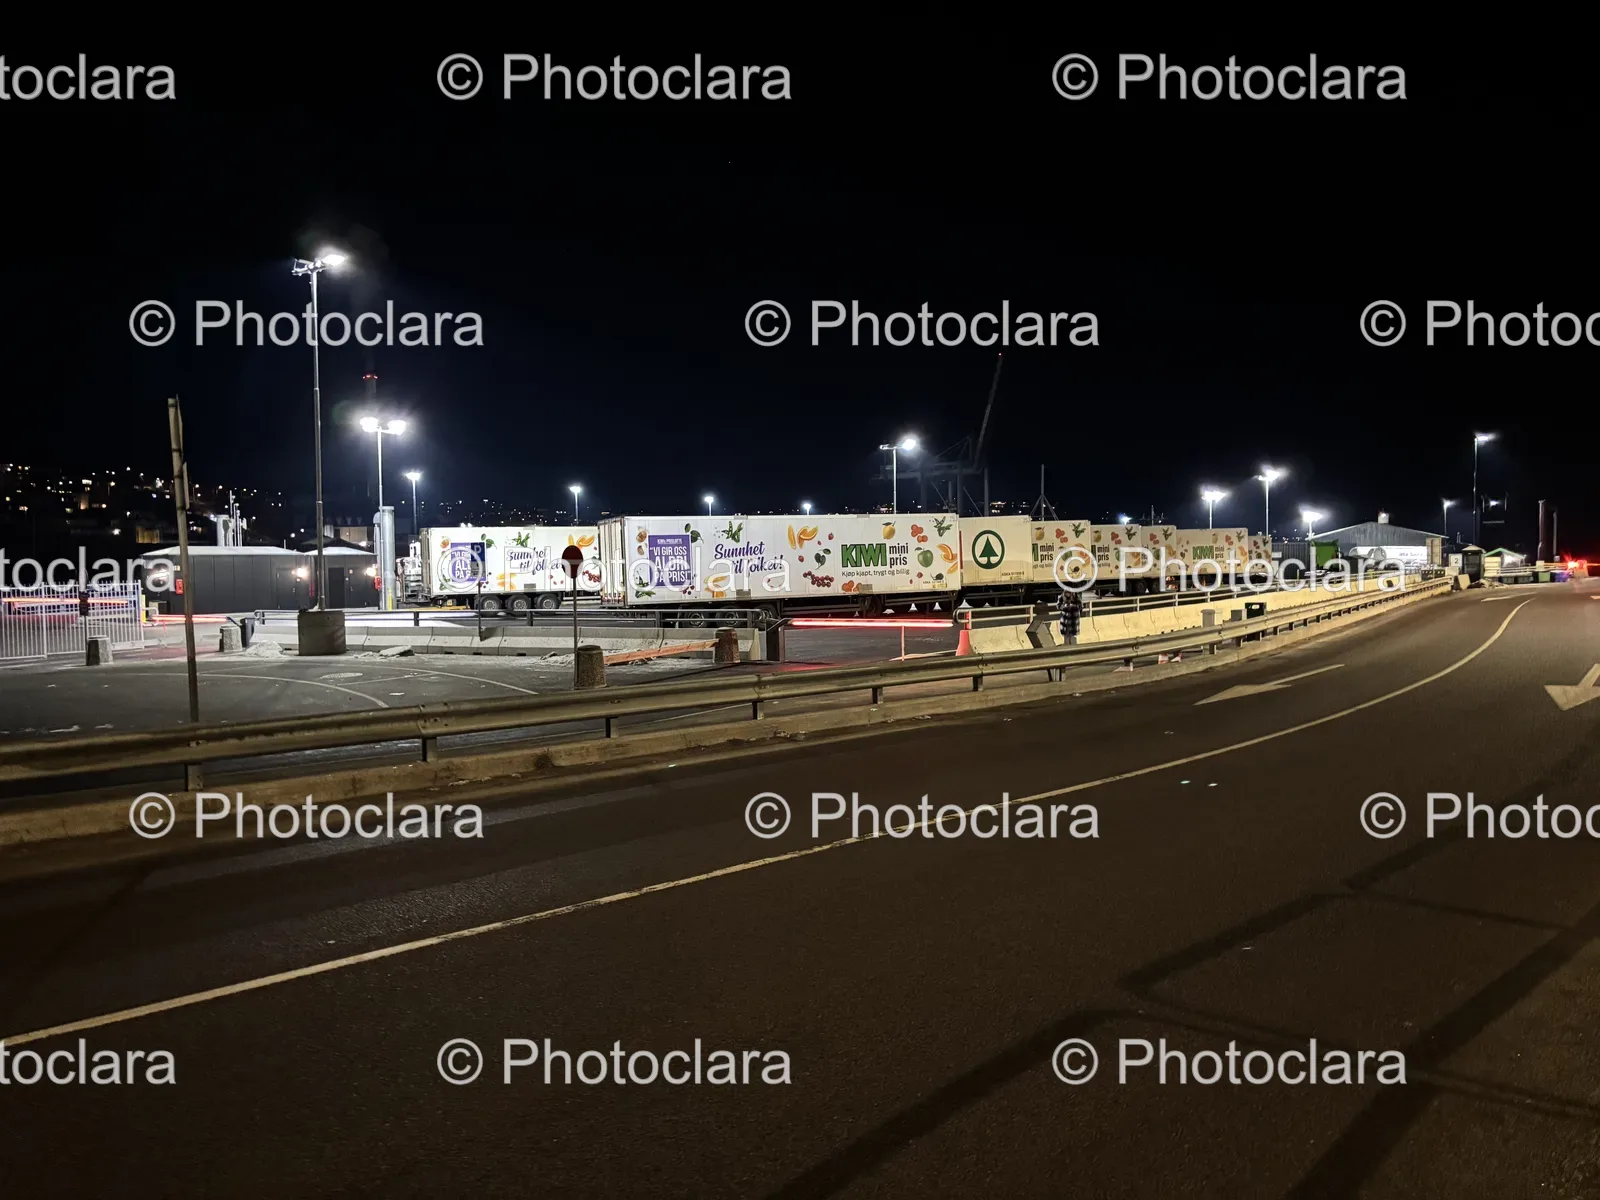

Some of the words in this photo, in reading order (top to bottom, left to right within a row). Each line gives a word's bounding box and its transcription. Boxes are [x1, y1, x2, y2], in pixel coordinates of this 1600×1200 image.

[661, 546, 673, 556] GIR
[674, 546, 687, 556] OSS
[714, 541, 765, 559] Sunnhet
[889, 543, 909, 554] mini
[1040, 543, 1054, 552] mini
[1097, 544, 1109, 553] mini
[1192, 545, 1214, 560] KIWI
[841, 543, 887, 568] KIWI
[1040, 552, 1053, 563] pris
[1097, 553, 1109, 562] pris
[889, 555, 908, 568] pris
[842, 570, 856, 578] Kjøp
[856, 569, 873, 577] kjapt,
